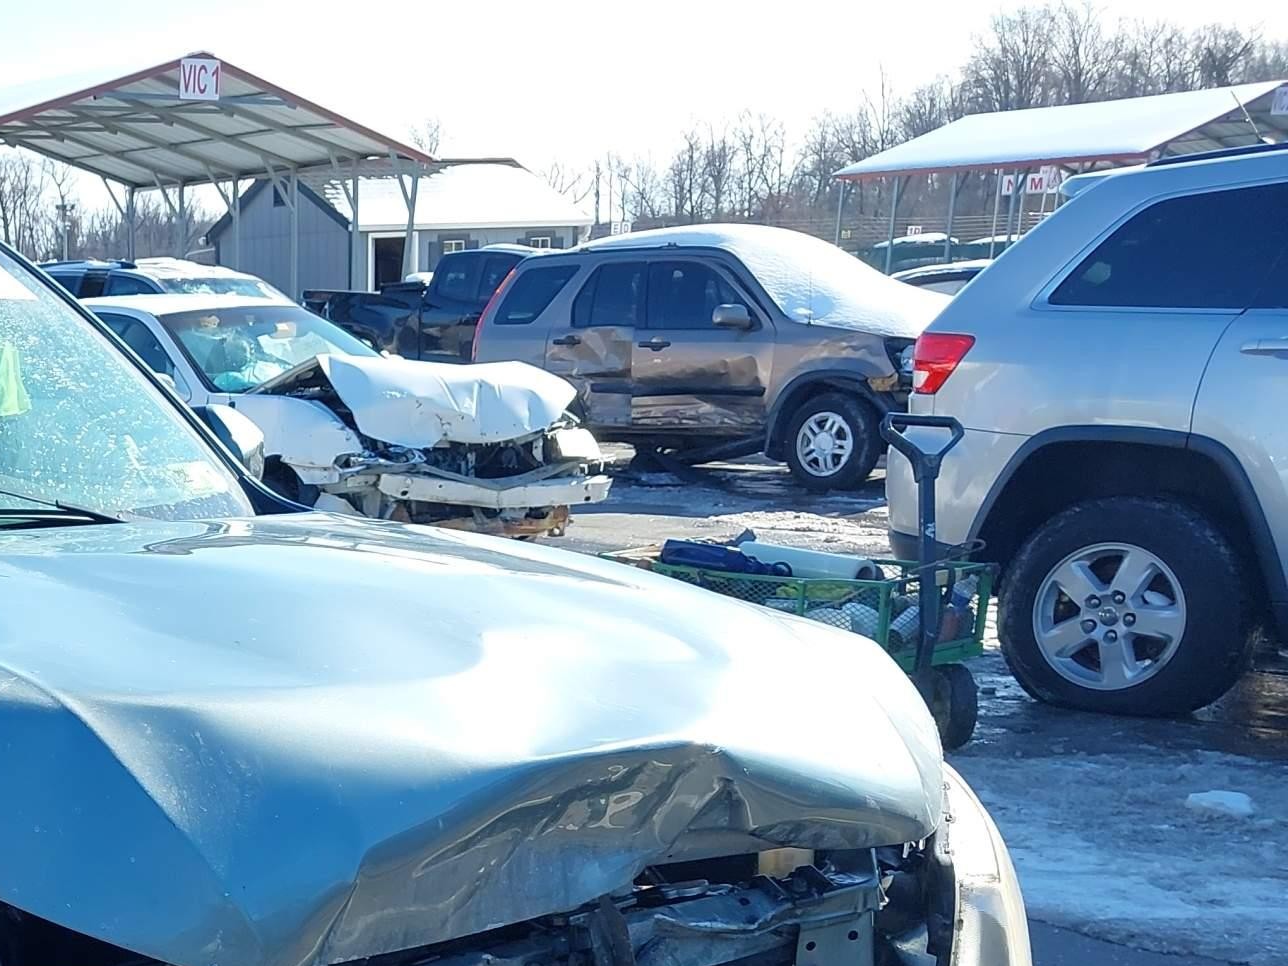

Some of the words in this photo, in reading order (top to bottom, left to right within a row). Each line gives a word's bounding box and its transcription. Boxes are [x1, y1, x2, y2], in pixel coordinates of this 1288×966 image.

[182, 63, 208, 95] VIC
[211, 65, 220, 95] 1
[1030, 177, 1043, 191] M
